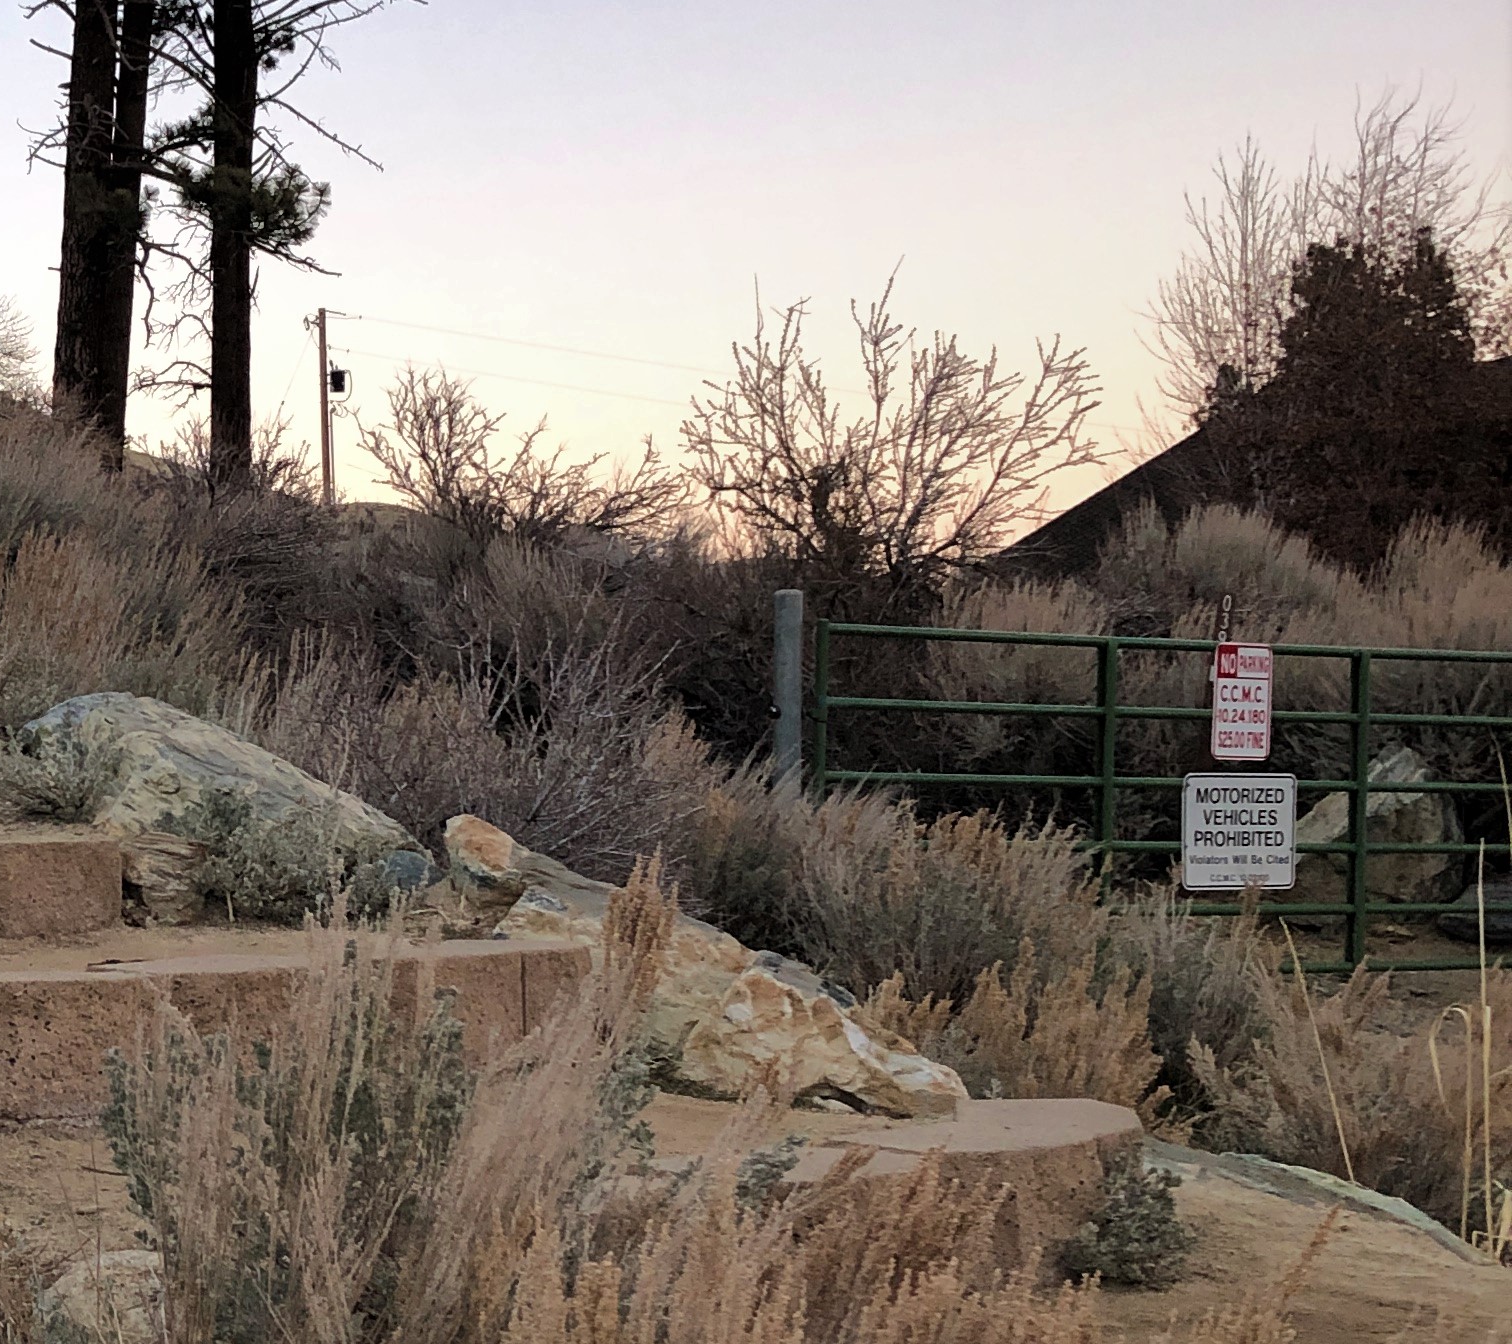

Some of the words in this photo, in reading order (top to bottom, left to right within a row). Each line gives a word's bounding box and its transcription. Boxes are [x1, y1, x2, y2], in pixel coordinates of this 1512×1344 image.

[1220, 653, 1236, 674] NO
[1238, 655, 1270, 674] PARKING
[1246, 731, 1265, 750] FINE
[1195, 787, 1285, 804] MOTORIZED
[1202, 809, 1278, 826] VEHICLES
[1194, 830, 1285, 847] PROHIBITED
[1189, 854, 1229, 865] Violators
[1232, 854, 1248, 865] Will
[1251, 854, 1263, 865] Be
[1266, 854, 1289, 865] Cited
